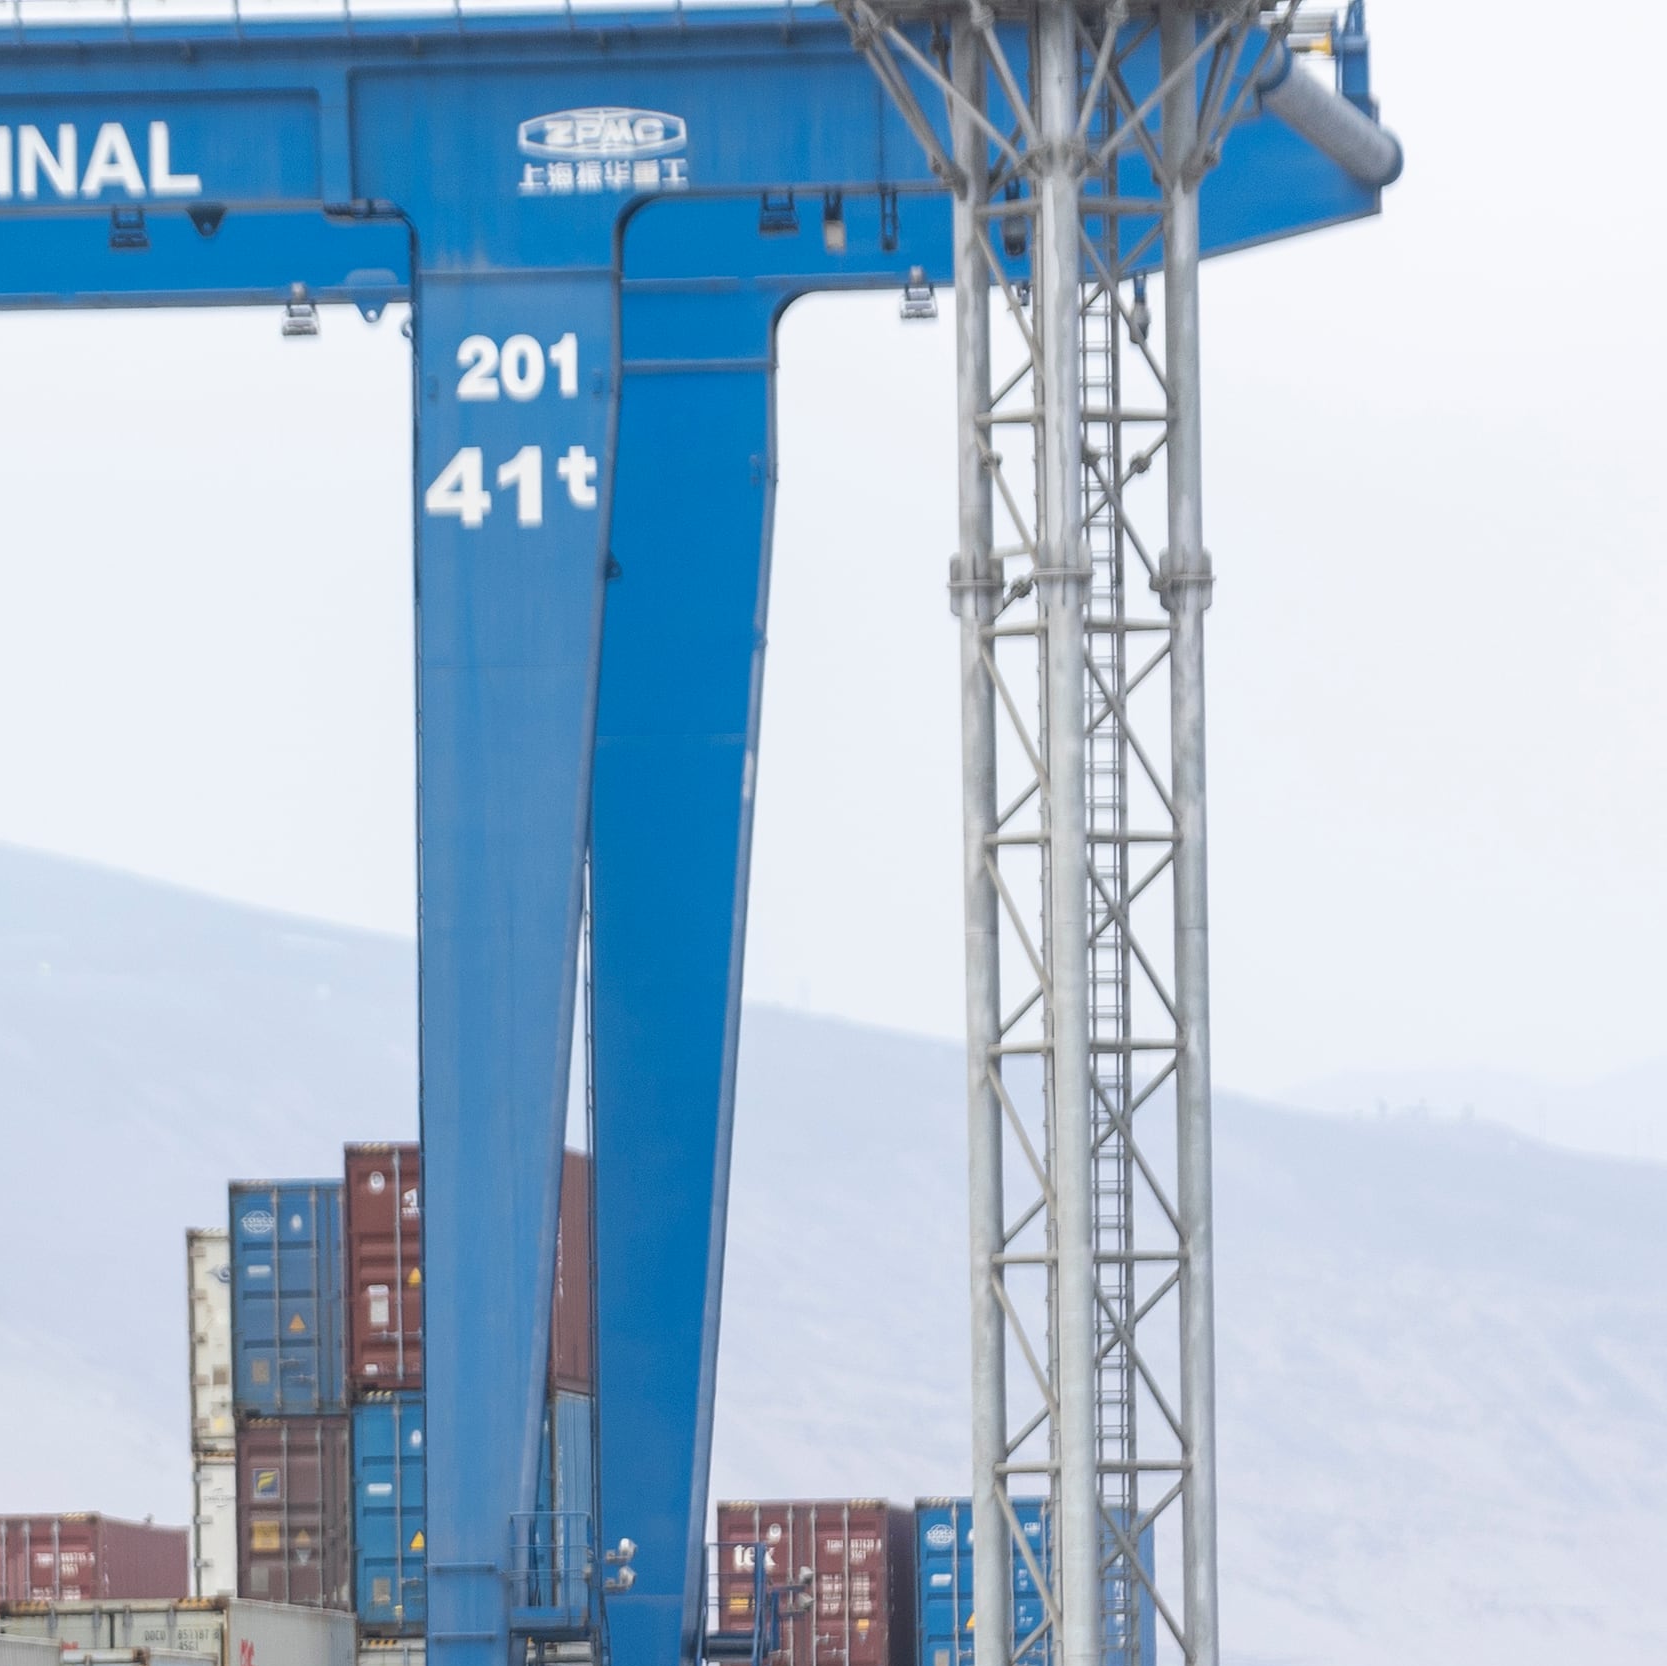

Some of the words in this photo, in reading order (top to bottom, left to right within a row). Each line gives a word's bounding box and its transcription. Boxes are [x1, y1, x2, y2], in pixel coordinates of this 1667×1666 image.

[544, 118, 665, 147] ZPMC
[455, 331, 581, 400] 201
[424, 444, 599, 529] 41t
